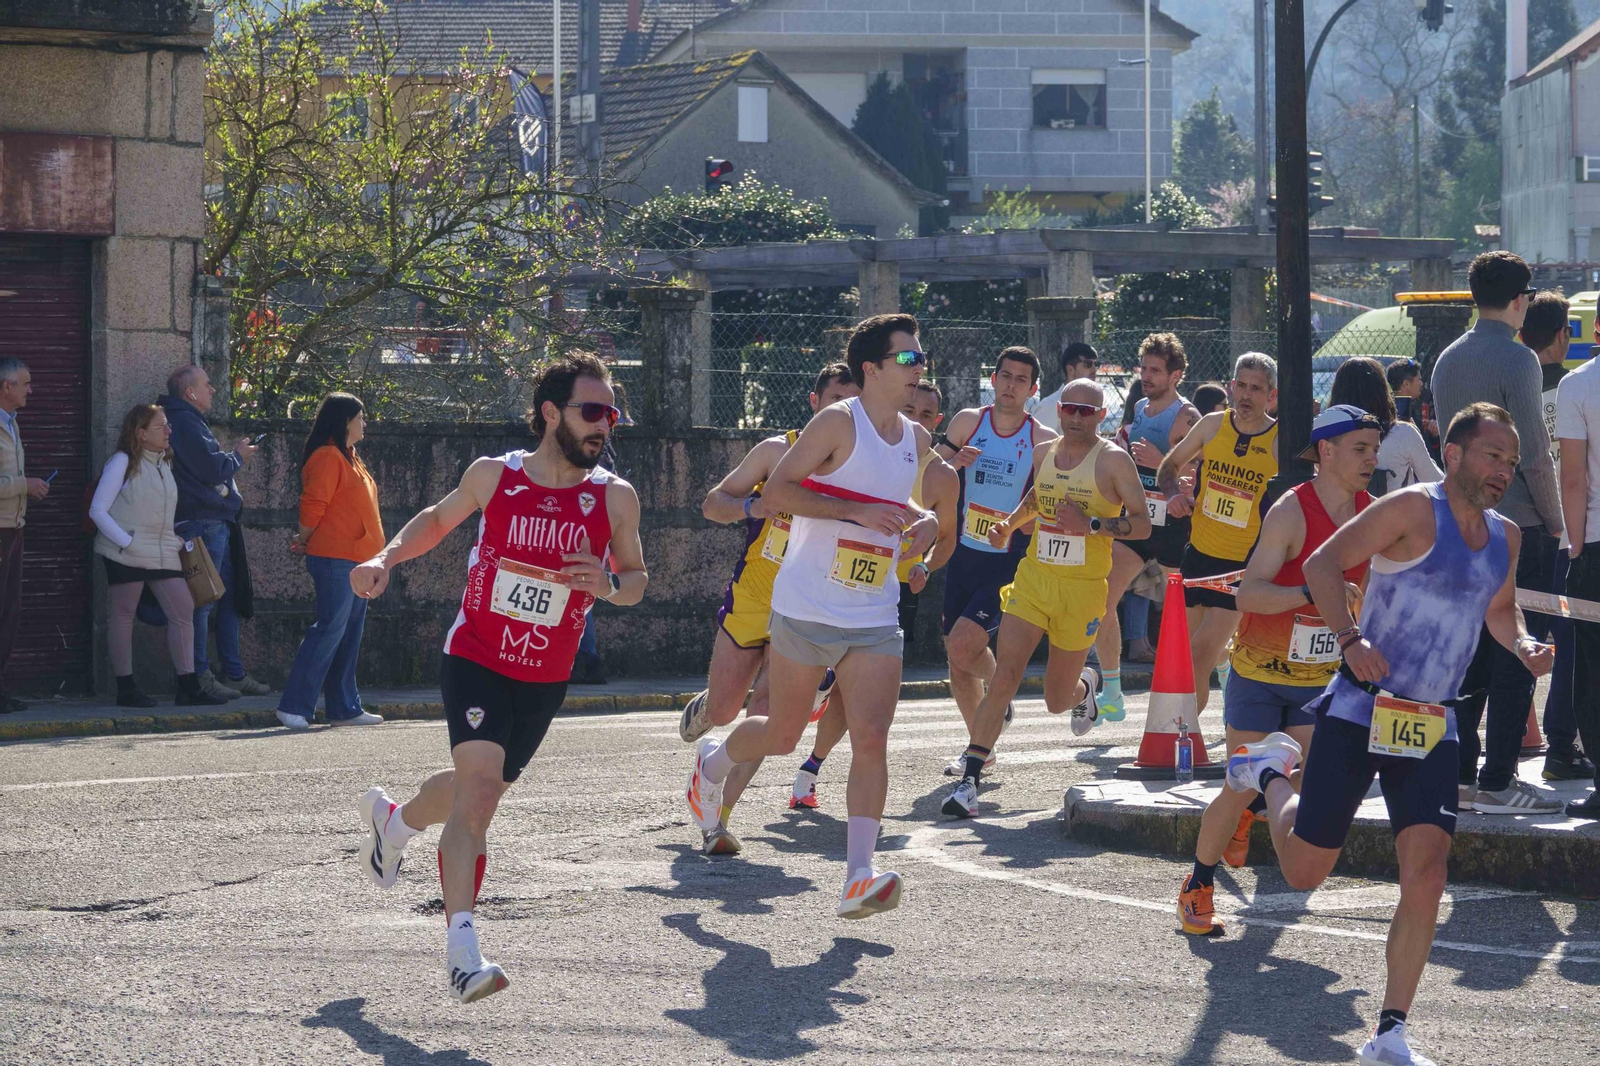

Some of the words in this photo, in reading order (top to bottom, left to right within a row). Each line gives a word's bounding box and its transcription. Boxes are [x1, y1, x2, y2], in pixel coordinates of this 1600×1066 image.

[980, 457, 1003, 466] CONCELLO
[1207, 459, 1265, 484] TANINOS
[1206, 471, 1260, 493] PONTEAREAS
[1216, 497, 1235, 517] 115
[507, 514, 588, 553] ARTEFACTO
[1048, 539, 1070, 558] 177
[850, 557, 878, 584] 125
[516, 575, 535, 585] PEDRO
[536, 581, 552, 589] LUIS
[507, 583, 553, 615] 436
[501, 624, 552, 657] MS
[1309, 633, 1336, 655] 156
[499, 652, 543, 667] HOTELS
[1390, 711, 1408, 720] ROQUE
[1391, 718, 1426, 748] 145
